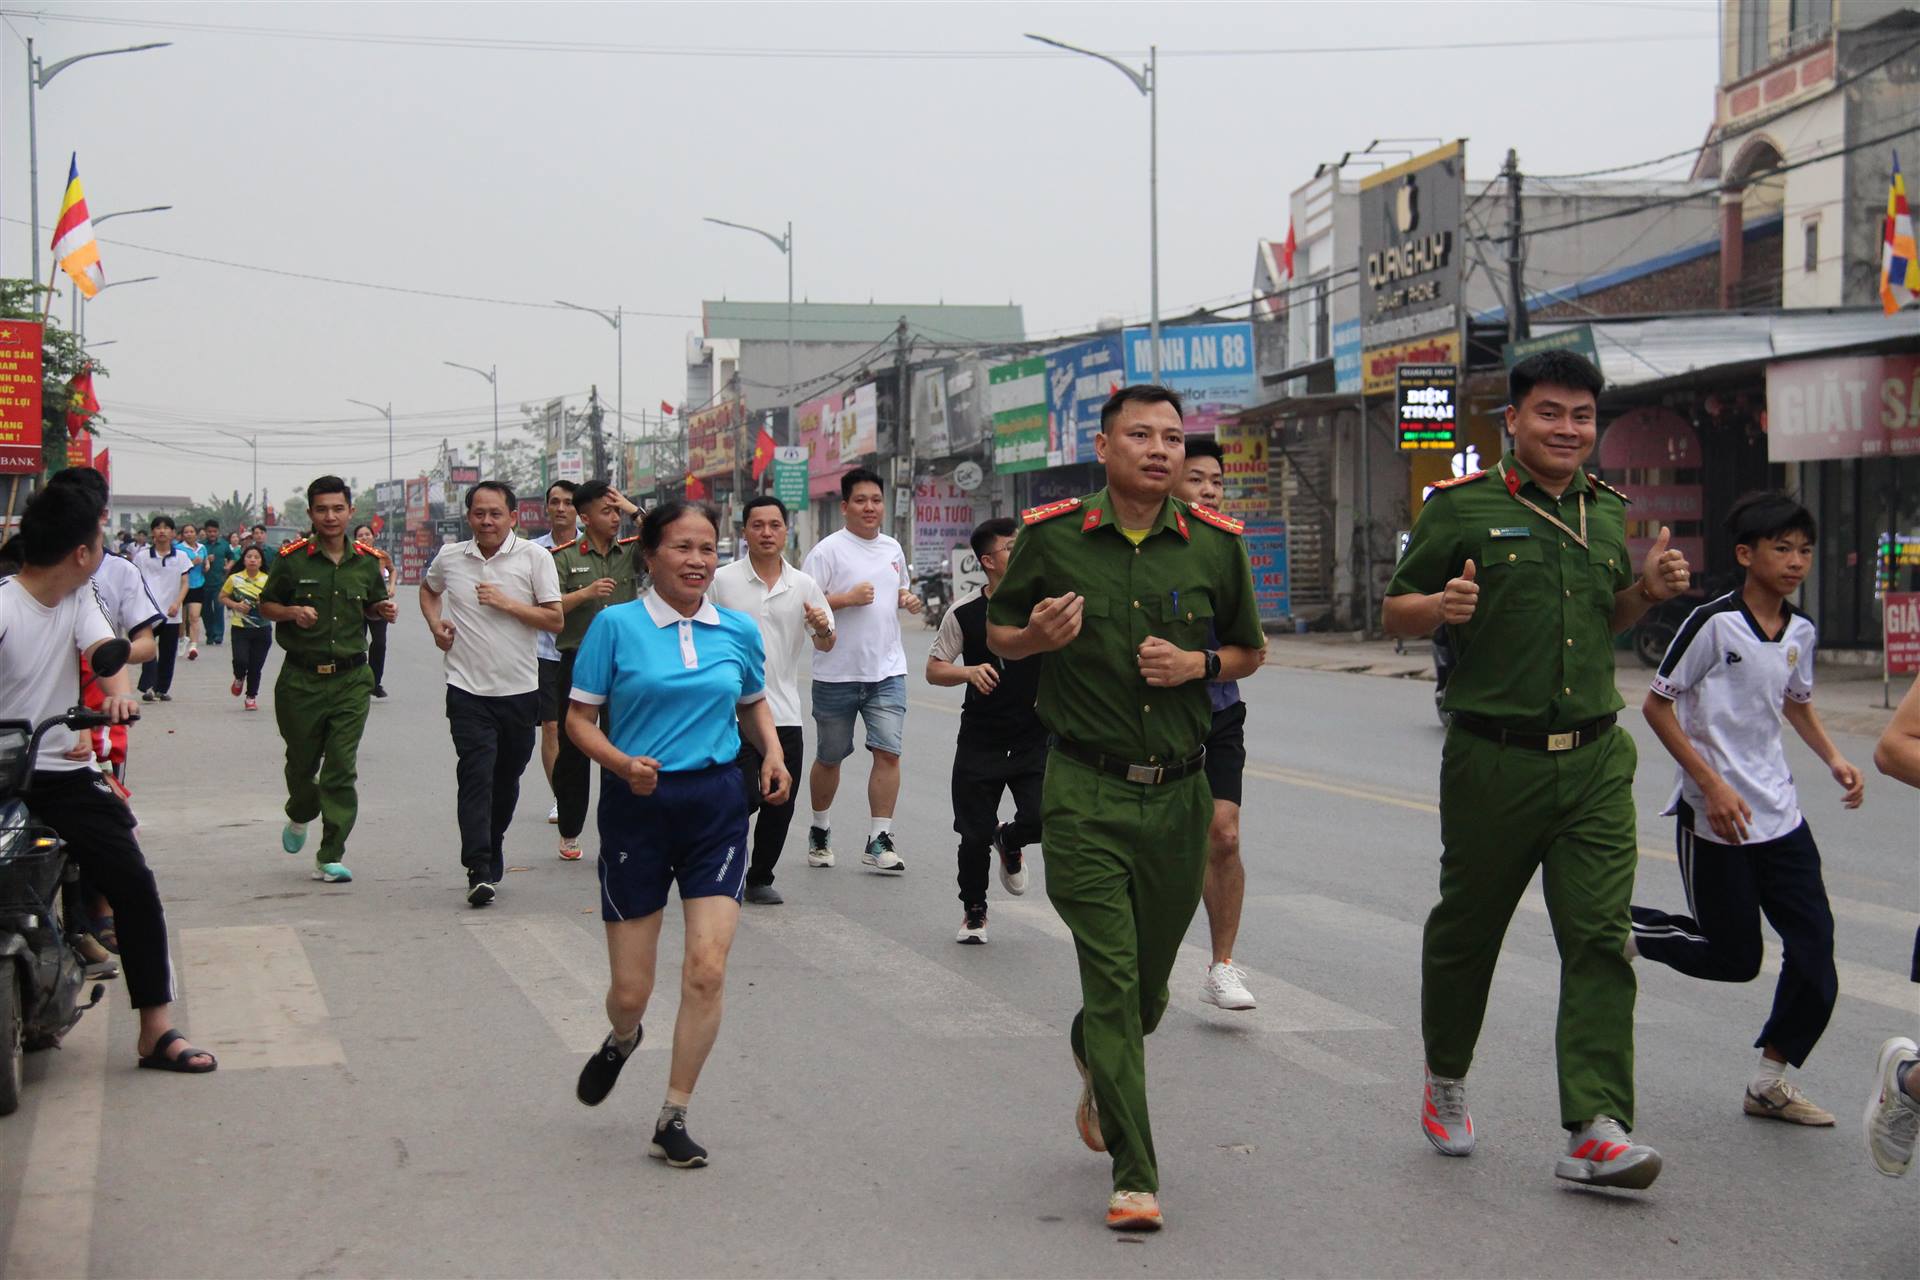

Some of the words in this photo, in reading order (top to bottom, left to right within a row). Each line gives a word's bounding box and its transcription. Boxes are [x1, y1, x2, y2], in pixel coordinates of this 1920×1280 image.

[1134, 337, 1187, 373] MNH
[1190, 335, 1218, 370] AN
[1221, 333, 1246, 369] 88
[1401, 368, 1433, 378] QUANG
[1434, 368, 1455, 378] HUY
[1407, 387, 1449, 405] ĐIỆN
[1400, 405, 1455, 421] THOẠI
[1778, 369, 1868, 444] GIẶT
[1, 457, 35, 466] BANK
[916, 506, 941, 523] HOA
[944, 504, 973, 523] TƯƠI
[1887, 597, 1920, 640] GIẶ
